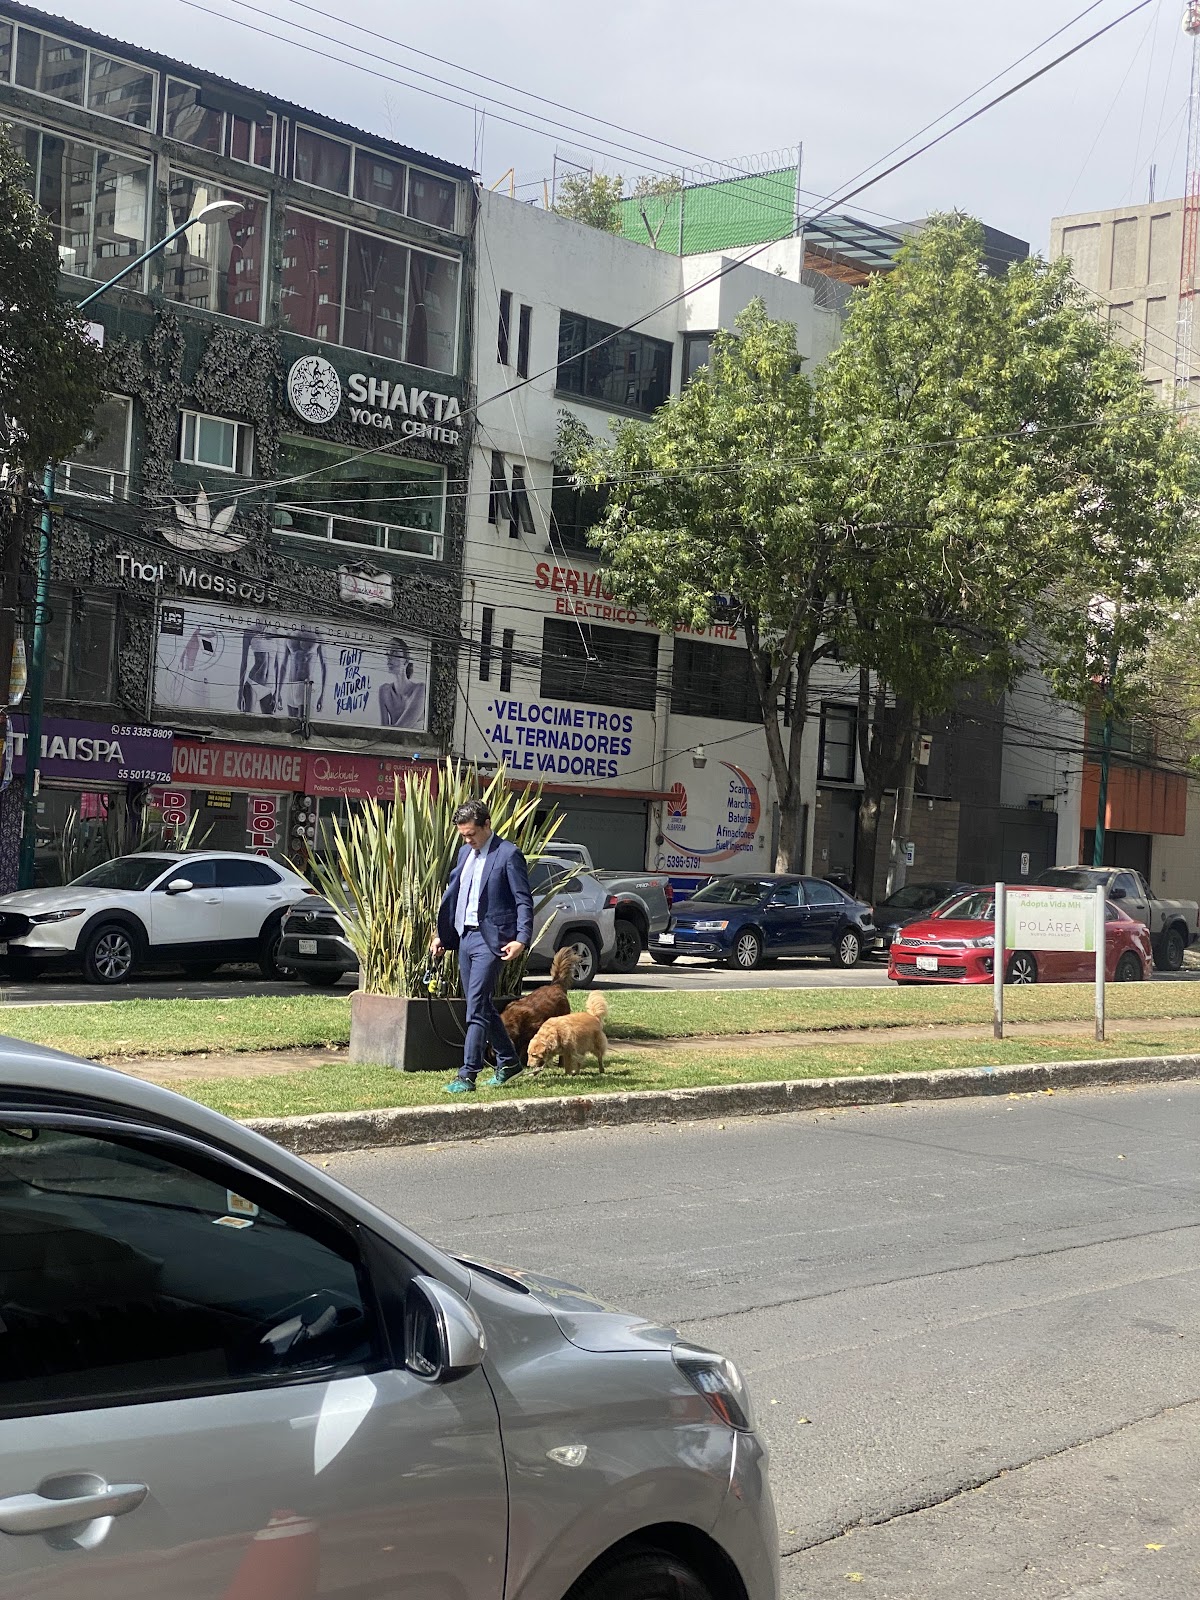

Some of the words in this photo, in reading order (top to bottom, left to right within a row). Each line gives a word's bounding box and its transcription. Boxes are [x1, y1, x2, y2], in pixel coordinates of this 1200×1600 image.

[348, 373, 462, 426] SHAKTA
[349, 406, 393, 431] YOGA
[401, 420, 459, 446] CENTER
[115, 554, 168, 583] Thai
[178, 566, 280, 604] Massage
[554, 597, 638, 625] ELECTRICO
[329, 628, 374, 642] CENTER
[344, 666, 362, 680] FOR
[333, 675, 372, 700] NATURAL
[336, 691, 370, 715] BEAUTY
[494, 699, 633, 733] VELOCIMETROS
[120, 726, 131, 737] 55
[132, 726, 152, 738] 3335
[152, 729, 174, 740] 8809
[491, 723, 632, 756] ALTERNADORES
[118, 769, 128, 780] 55
[223, 750, 302, 782] EXCHANGE
[502, 749, 618, 778] ELEVADORES
[313, 784, 335, 793] Polanco
[348, 786, 361, 794] Valle
[729, 780, 757, 795] Scanner
[727, 797, 756, 810] Marchas
[716, 824, 755, 840] Afinaciones
[1020, 900, 1049, 909] Adopta
[1050, 901, 1067, 909] Vida
